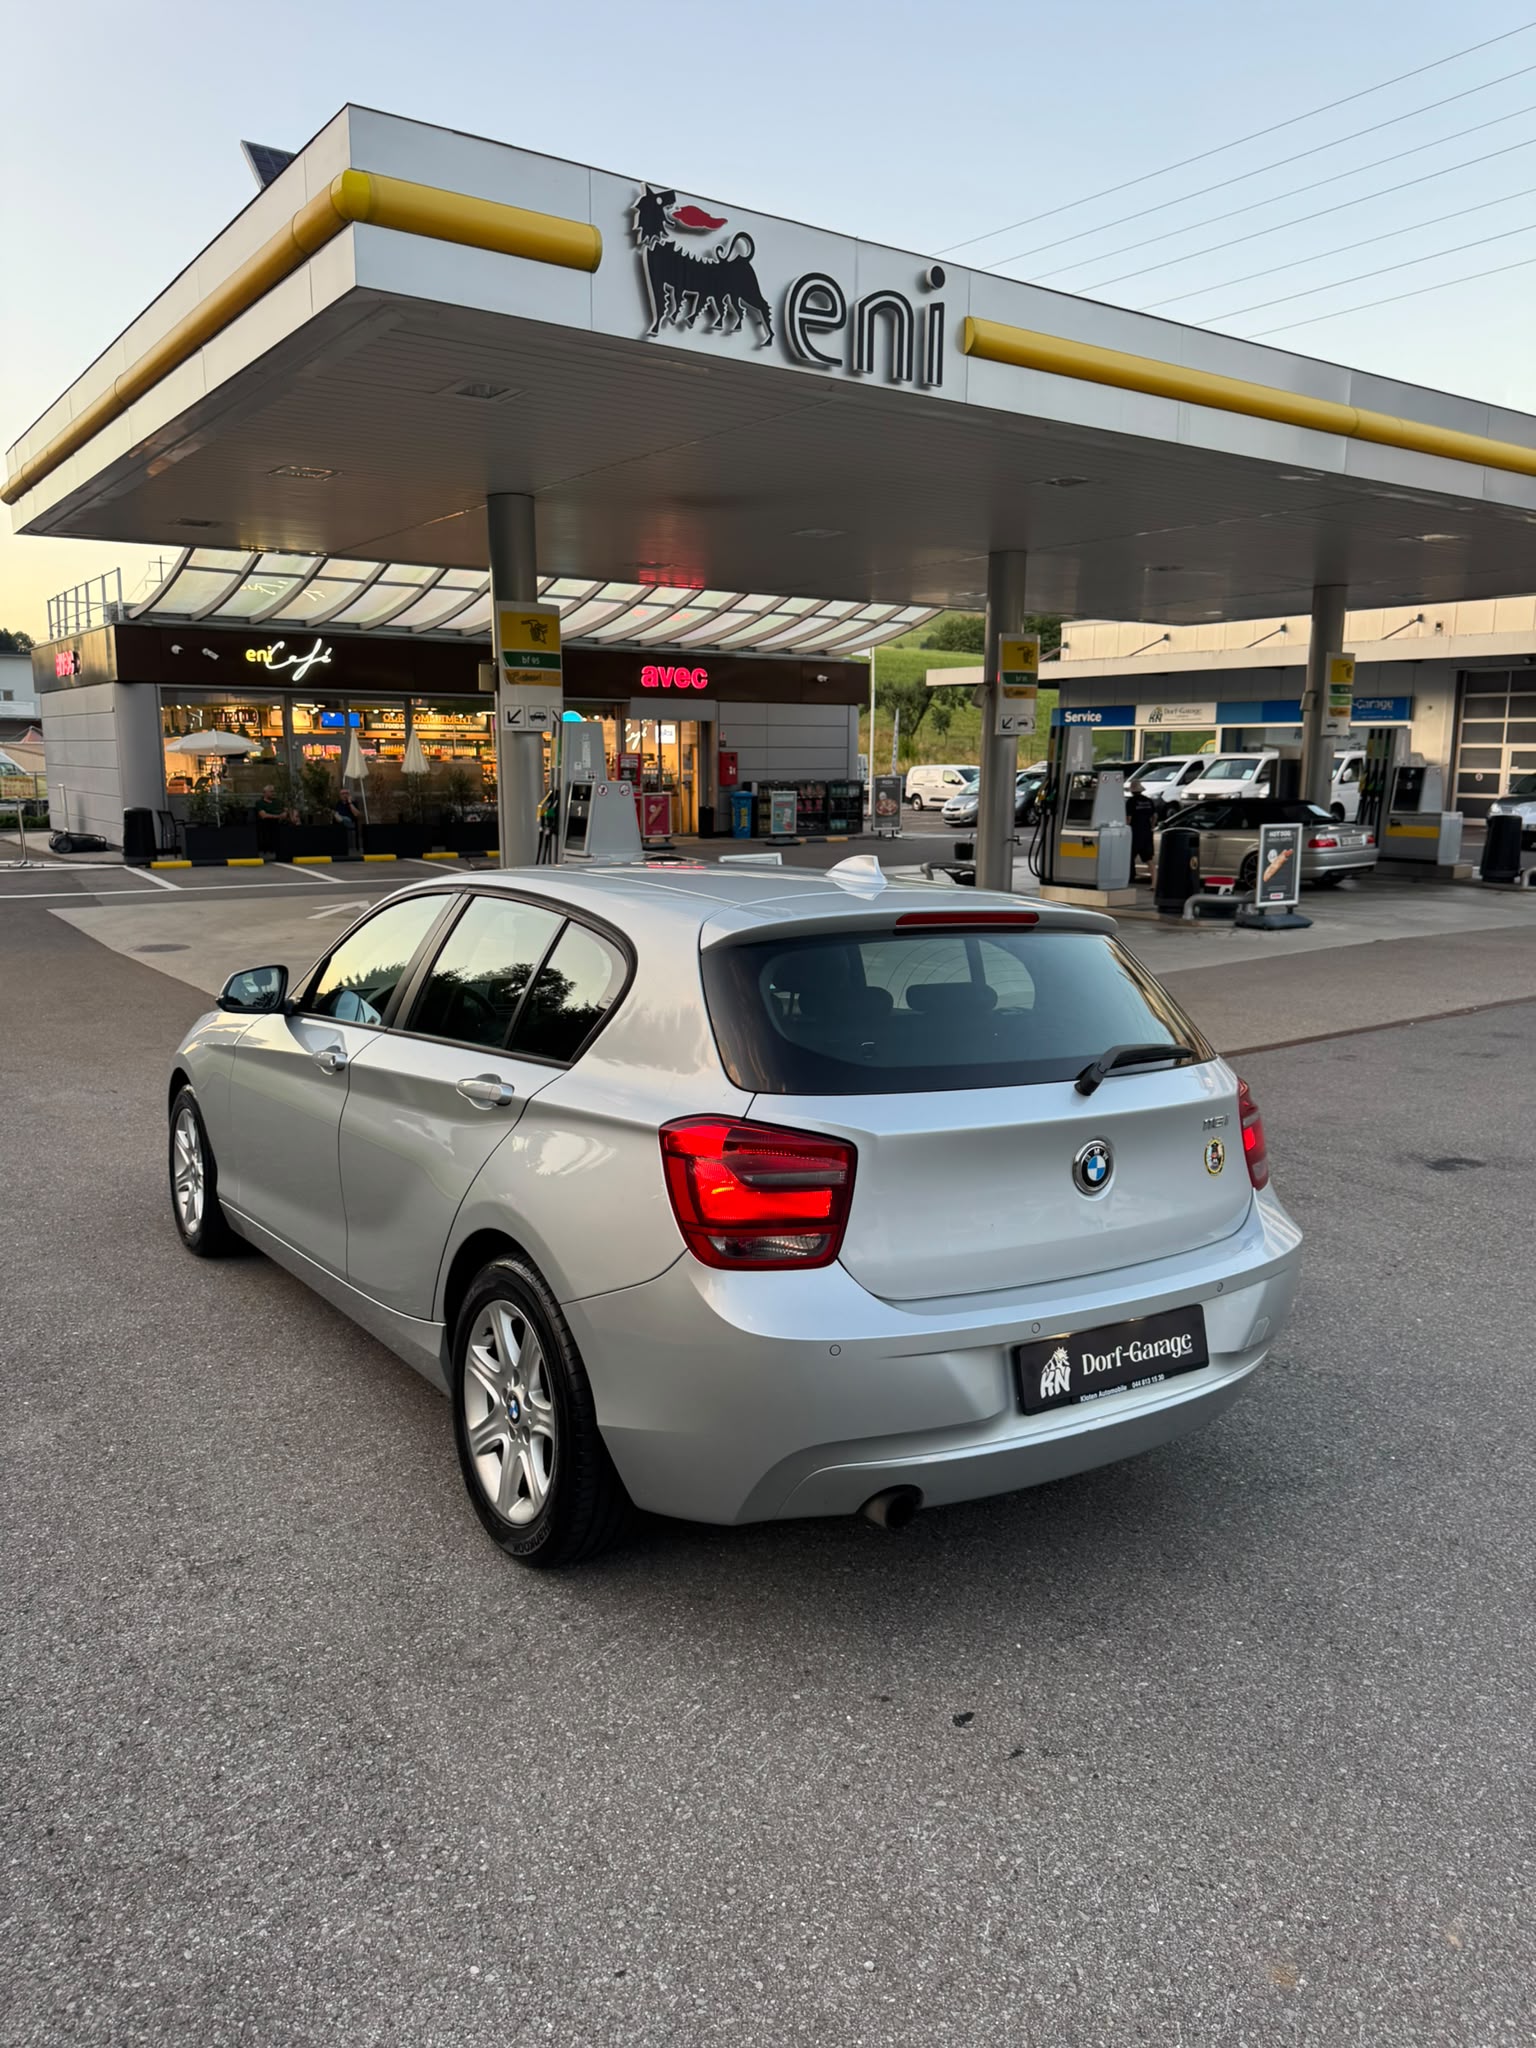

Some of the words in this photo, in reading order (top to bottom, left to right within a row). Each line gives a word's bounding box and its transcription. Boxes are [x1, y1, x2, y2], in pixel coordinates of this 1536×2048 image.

[785, 265, 945, 388] eni
[245, 645, 273, 663] eni
[641, 665, 708, 689] avec
[412, 713, 473, 724] OMMITMENT
[1064, 710, 1102, 722] Service
[577, 805, 582, 816] 1
[1084, 1147, 1109, 1163] BMW
[1081, 1333, 1192, 1376] Dorf-Garage
[1040, 1366, 1071, 1399] KN
[1080, 1392, 1097, 1402] Kloten
[1098, 1384, 1127, 1398] Automobile
[1131, 1380, 1141, 1389] 044
[1142, 1377, 1151, 1386] 813
[1158, 1373, 1165, 1381] 30
